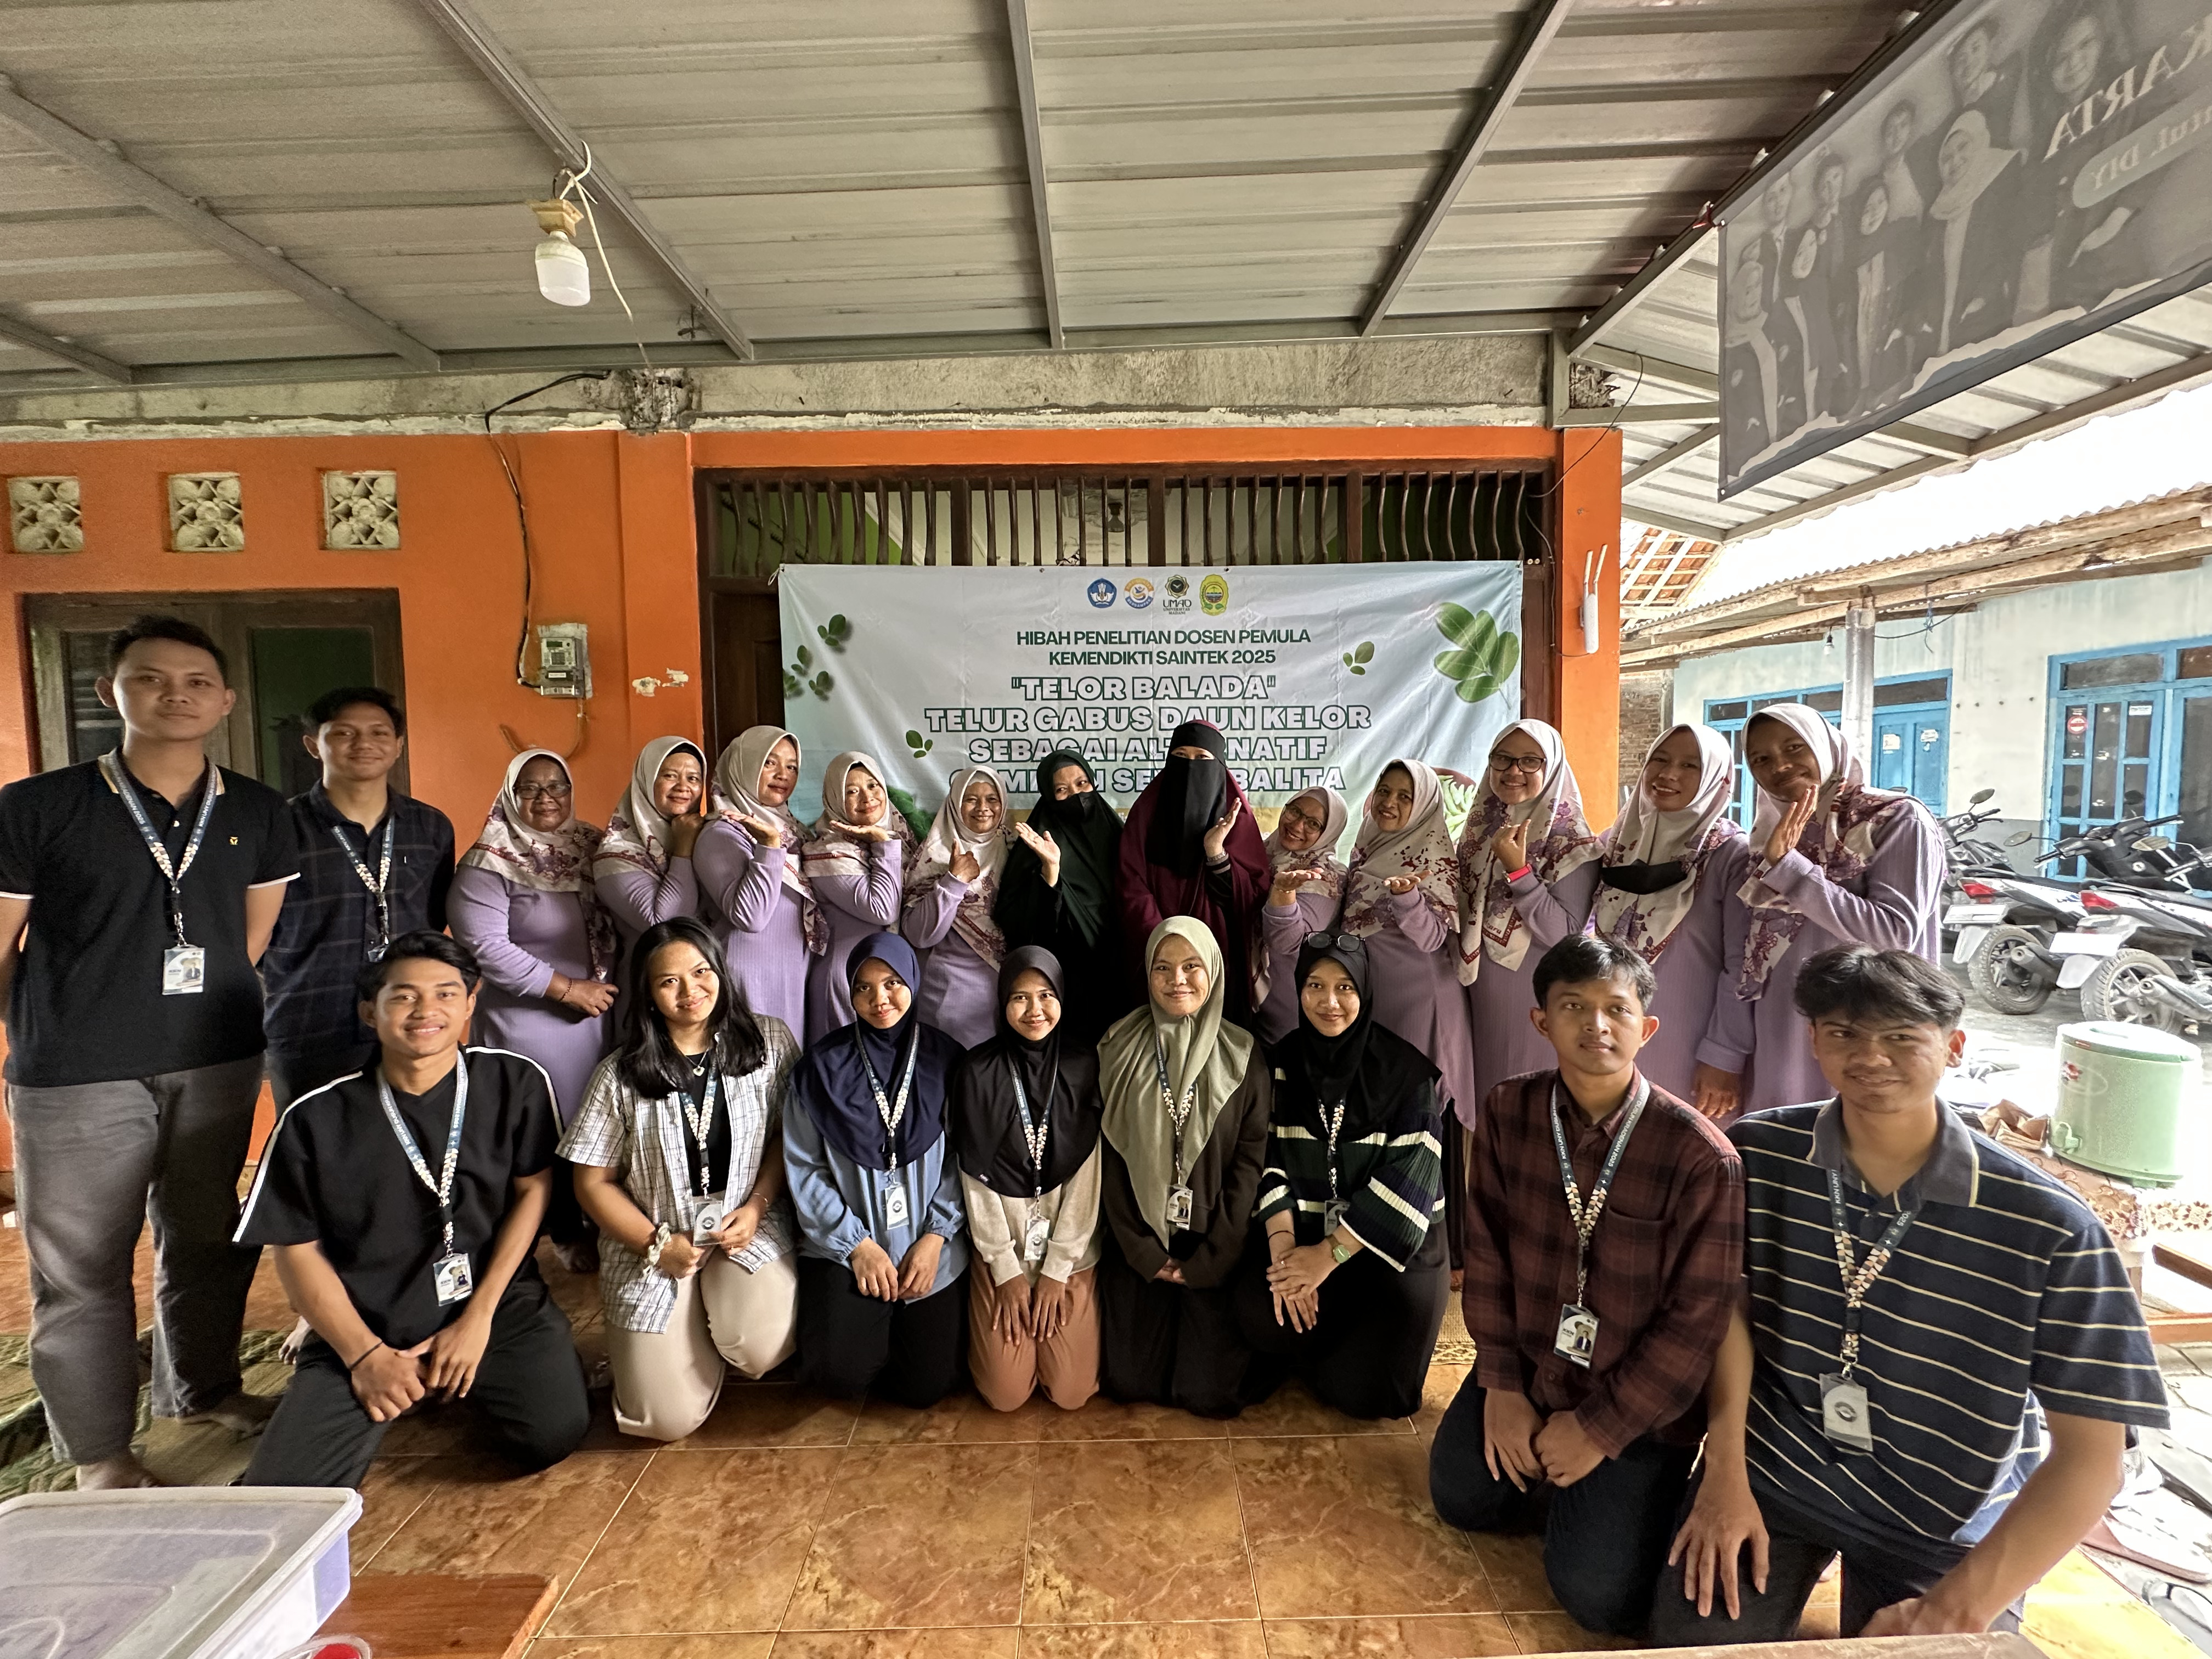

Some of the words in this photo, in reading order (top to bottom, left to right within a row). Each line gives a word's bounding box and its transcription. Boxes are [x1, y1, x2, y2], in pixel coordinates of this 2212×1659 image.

[1163, 599, 1192, 608] UMAD
[1017, 631, 1070, 645] HIBAH
[1074, 630, 1171, 645] PENELITIAN
[1174, 630, 1235, 645] DOSEN
[1238, 629, 1311, 644] PEMULA
[1049, 651, 1153, 665] KEMENDIKTI
[1156, 650, 1228, 665] SAINTEK
[1232, 650, 1276, 664] 2025
[1011, 676, 1126, 701] "TELOR
[1132, 675, 1276, 700] BALADA"
[924, 708, 1029, 732] TELUR
[1035, 707, 1153, 731] GABUS
[1261, 704, 1372, 730] KELOR
[1614, 1120, 1632, 1153] KRADENAN
[1608, 1151, 1618, 1167] 2025
